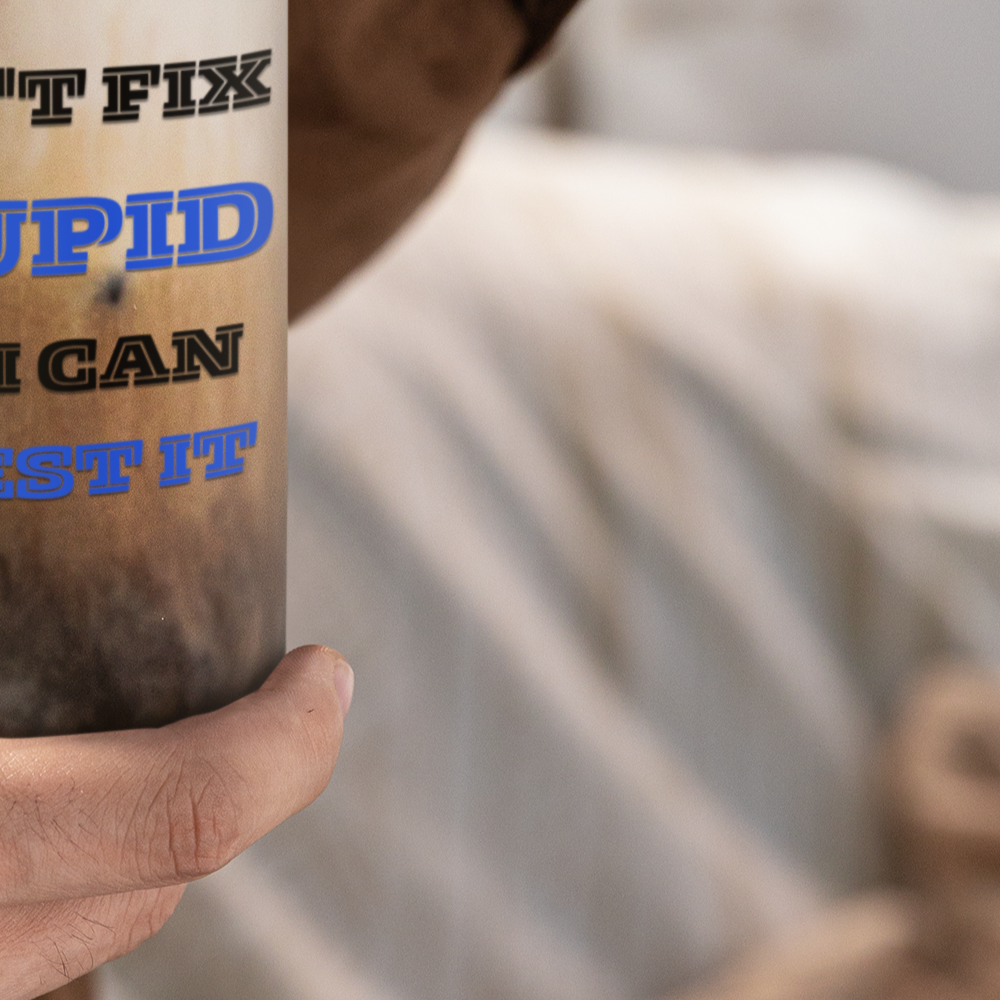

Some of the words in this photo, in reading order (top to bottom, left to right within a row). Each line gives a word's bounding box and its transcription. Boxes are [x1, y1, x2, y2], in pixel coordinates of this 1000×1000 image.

[102, 49, 272, 123] FIX
[37, 323, 244, 392] CAN
[159, 421, 258, 487] IT
